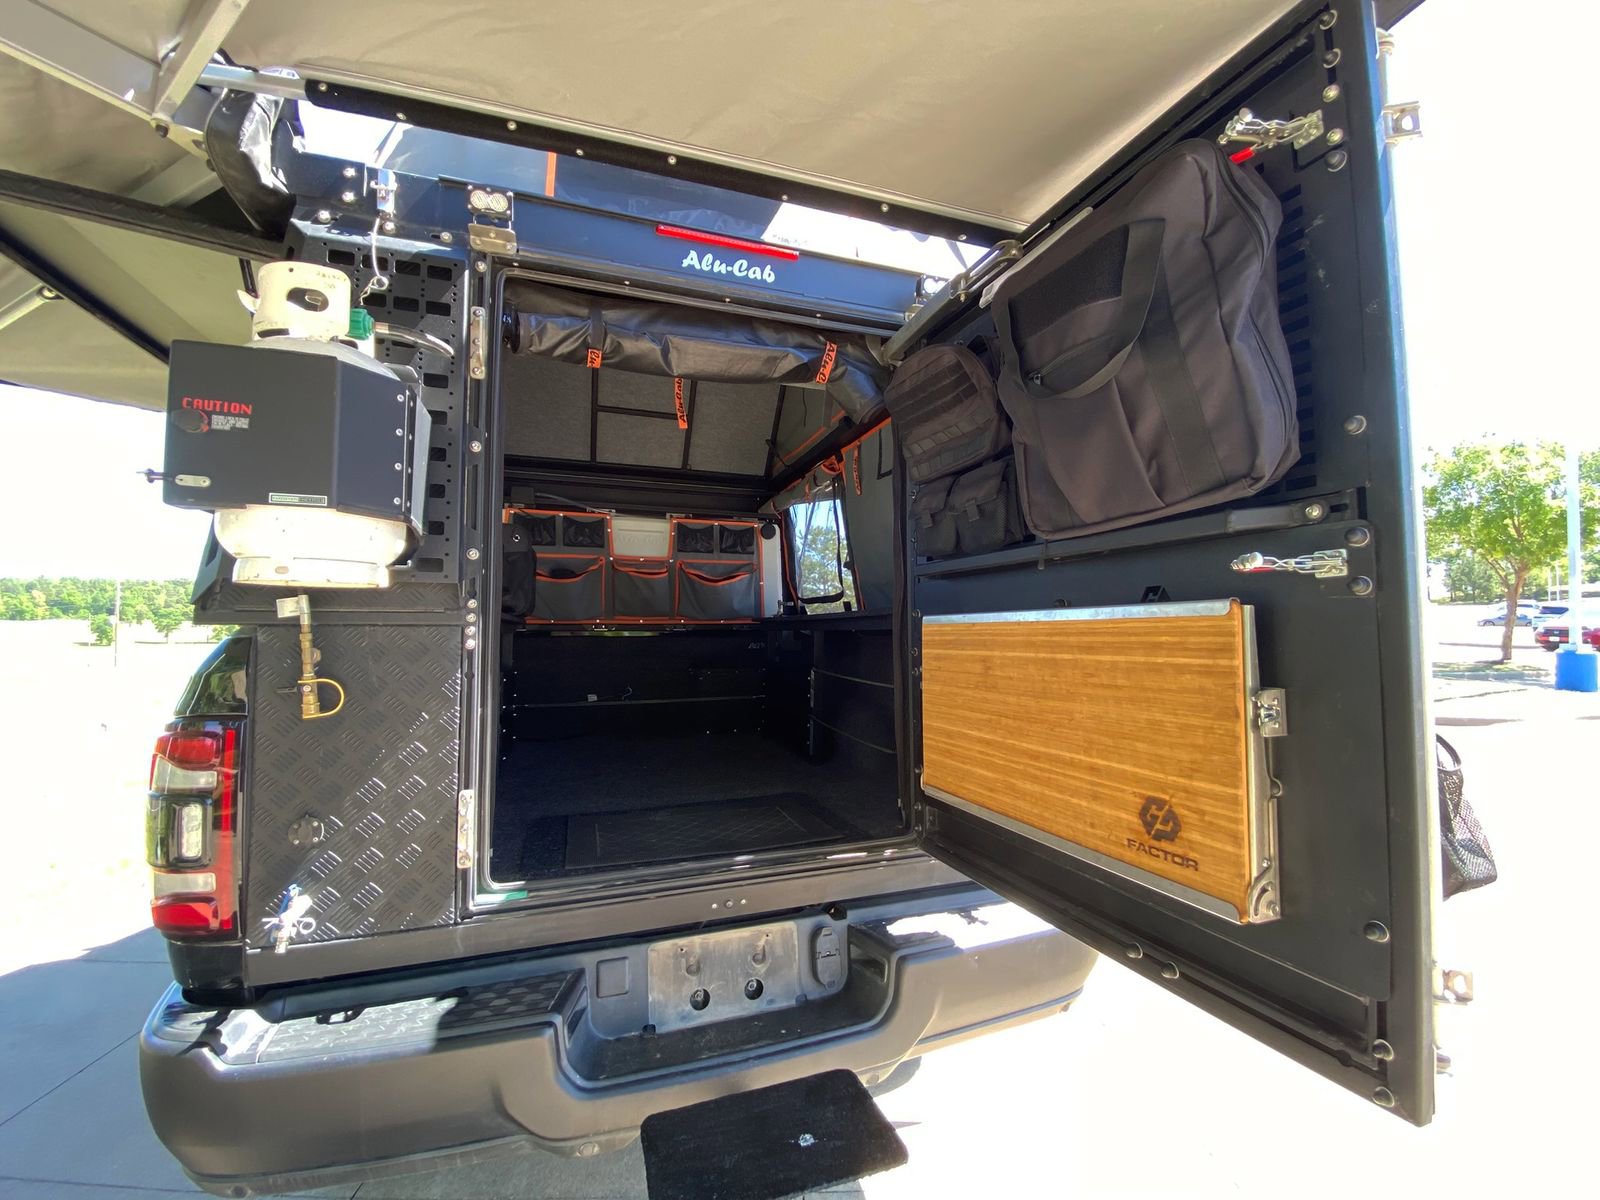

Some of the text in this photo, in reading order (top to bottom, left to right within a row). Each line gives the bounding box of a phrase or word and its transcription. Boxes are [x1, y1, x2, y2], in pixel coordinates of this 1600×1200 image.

[682, 250, 776, 283] Alu-Cab
[182, 396, 252, 415] CAUTION
[1126, 838, 1199, 871] FACTOR
